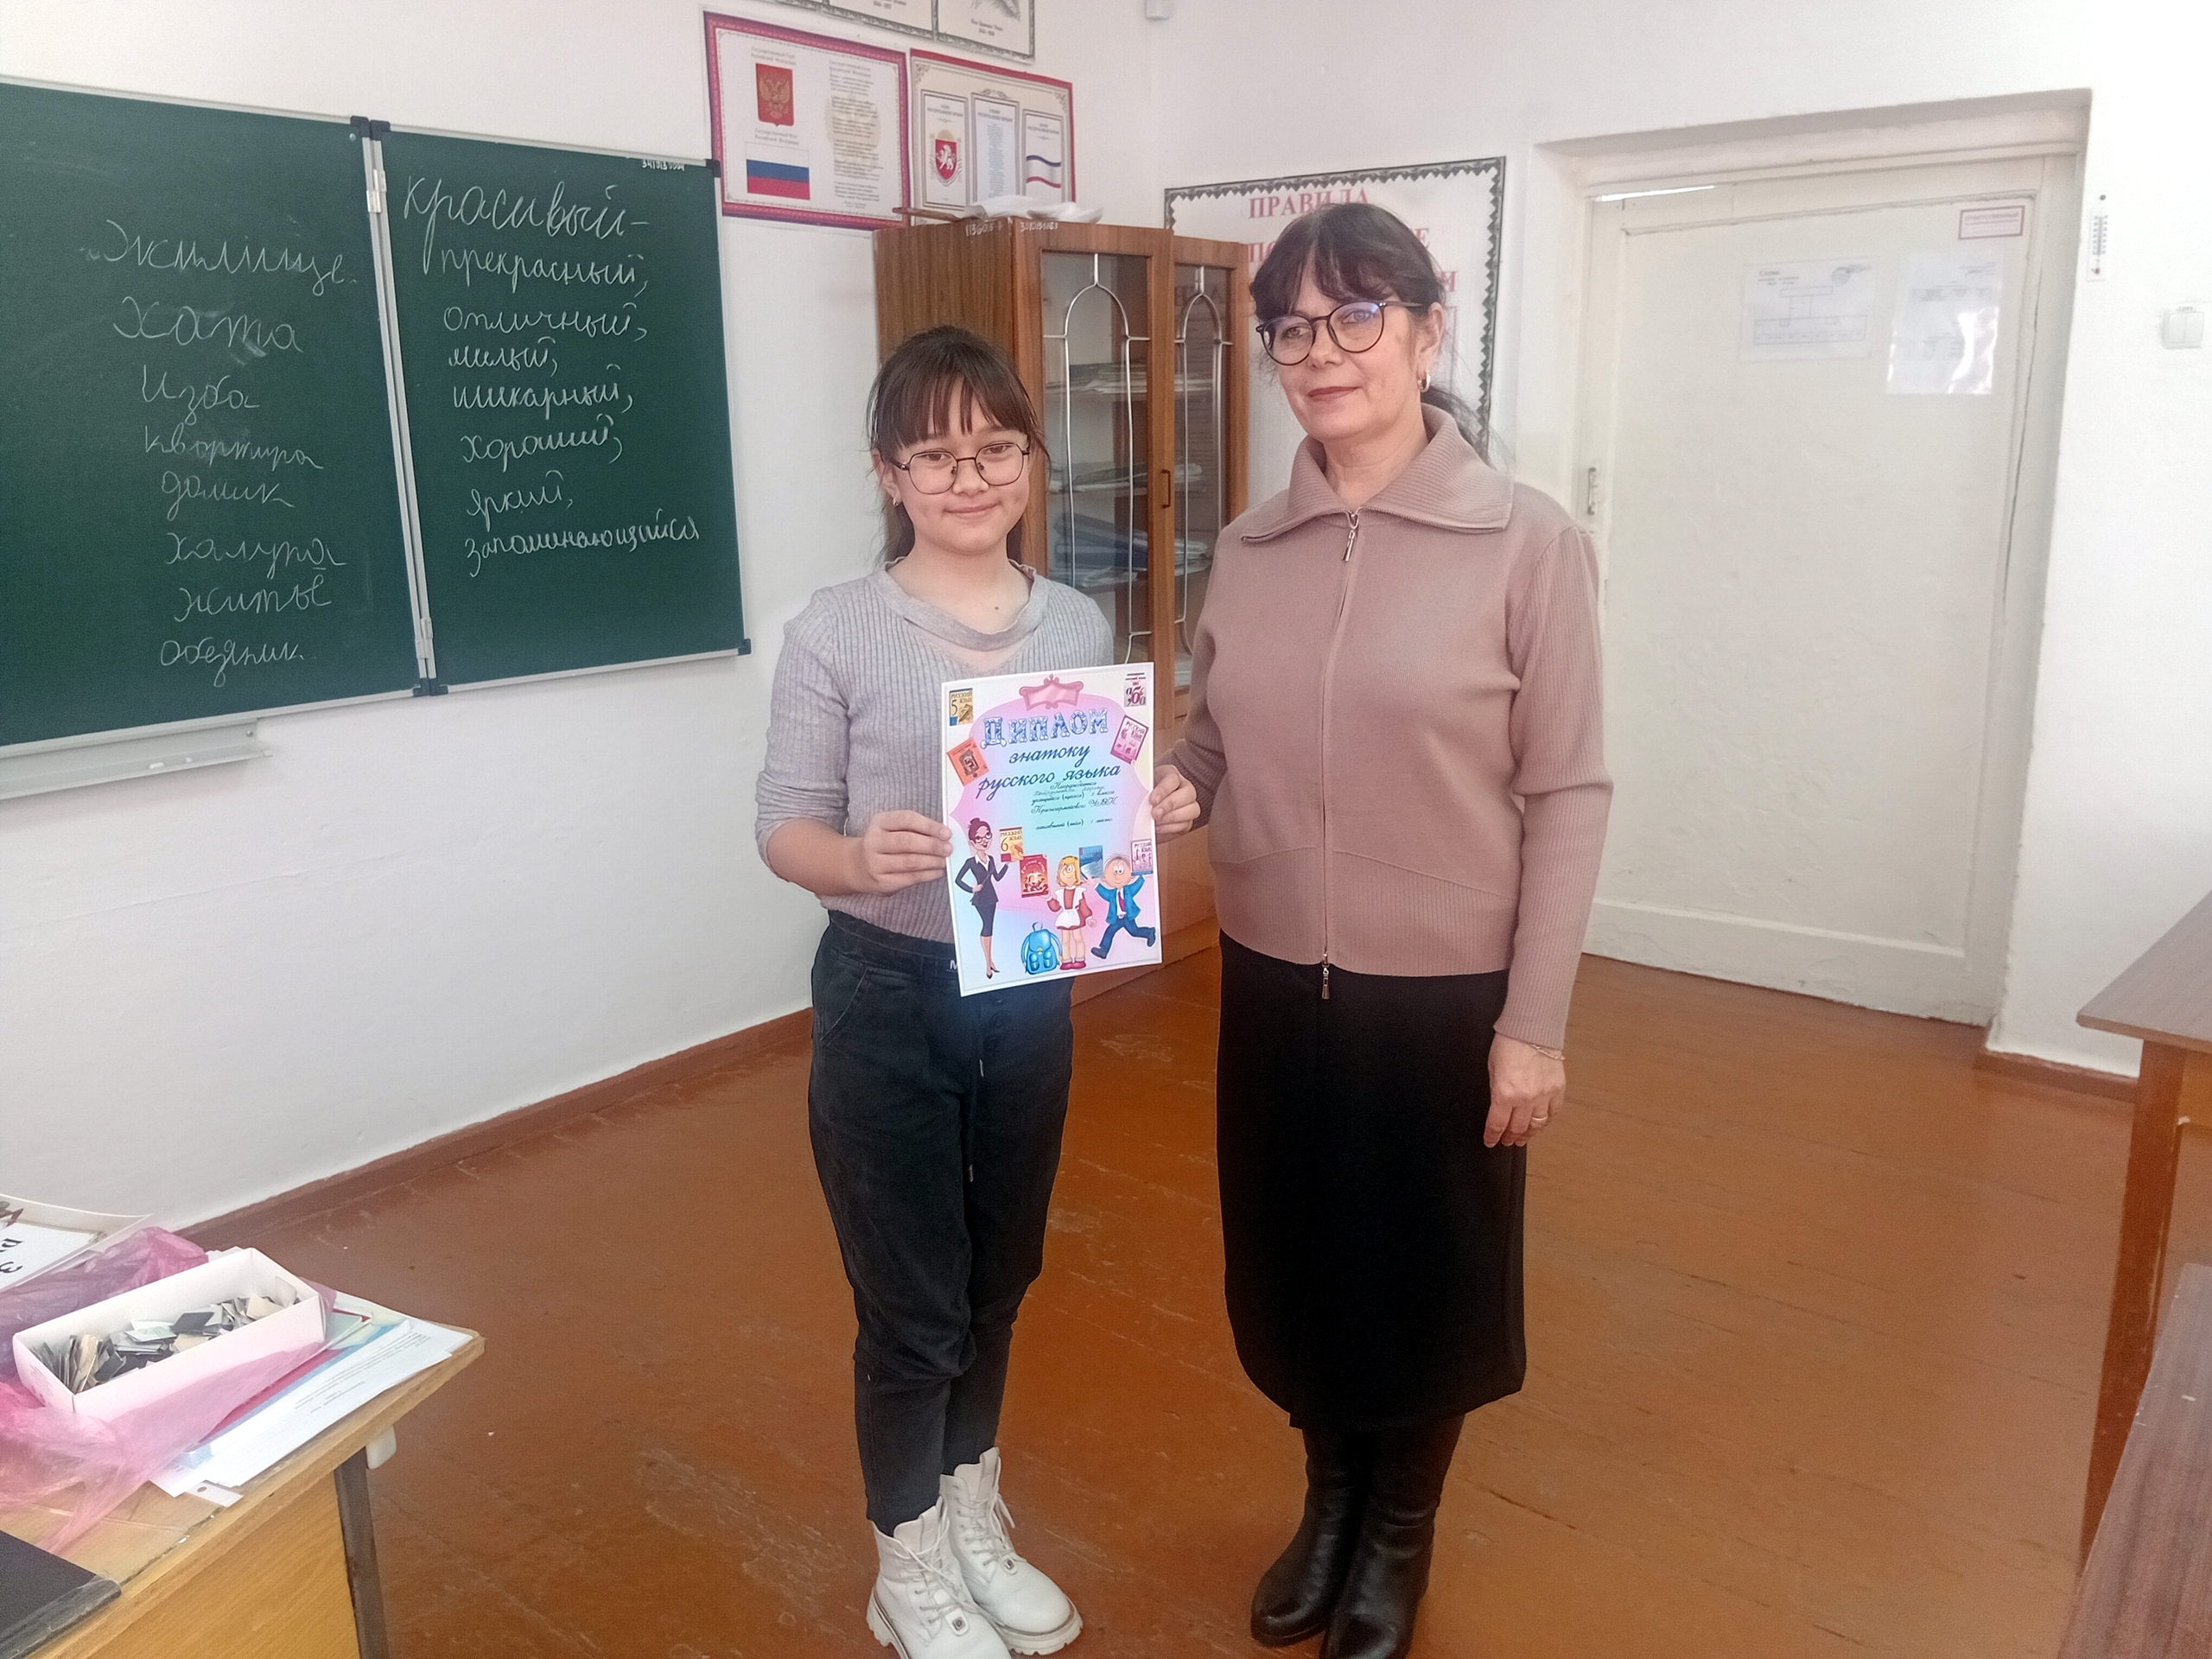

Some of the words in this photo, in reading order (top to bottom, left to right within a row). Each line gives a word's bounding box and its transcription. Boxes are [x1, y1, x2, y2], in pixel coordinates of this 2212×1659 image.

[951, 699, 958, 716] 5
[981, 708, 1109, 749] ДИПЛОМ
[1009, 746, 1090, 768] знатоку
[976, 772, 1056, 802] русского
[1063, 765, 1121, 782] языка
[1001, 836, 1009, 852] 6
